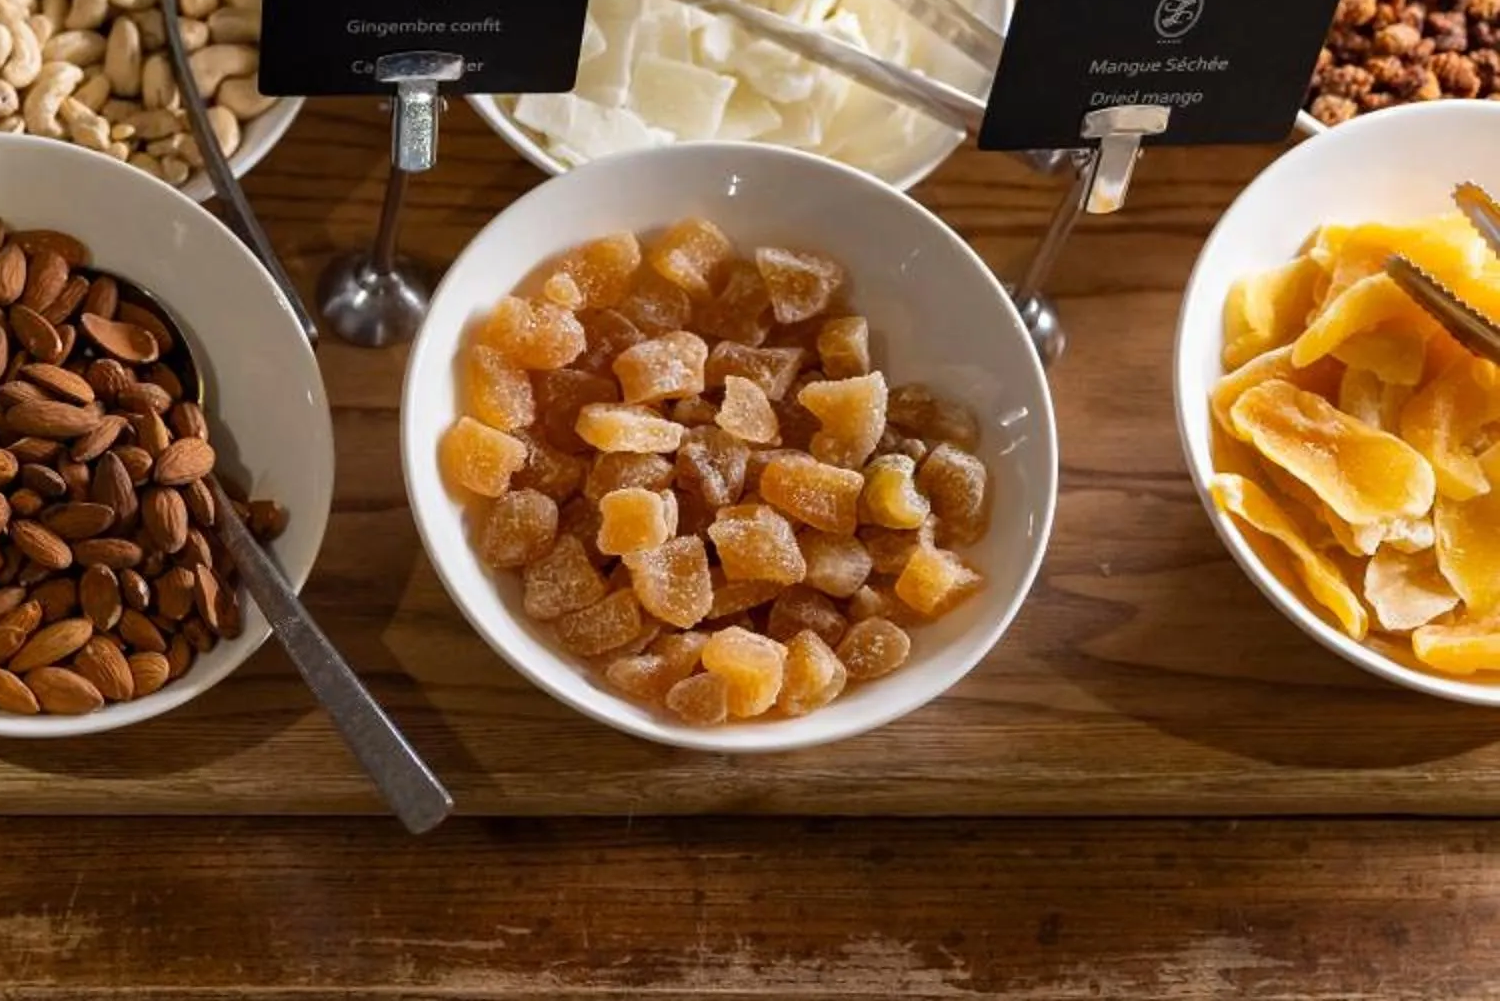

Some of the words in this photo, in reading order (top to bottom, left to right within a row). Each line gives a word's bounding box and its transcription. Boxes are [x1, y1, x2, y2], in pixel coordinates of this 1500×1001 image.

[347, 18, 446, 37] Gingembre
[451, 16, 501, 33] confit
[1088, 59, 1161, 77] Mangue
[1164, 55, 1229, 72] Séchée
[1089, 90, 1139, 106] Dried
[1142, 90, 1204, 108] mango
